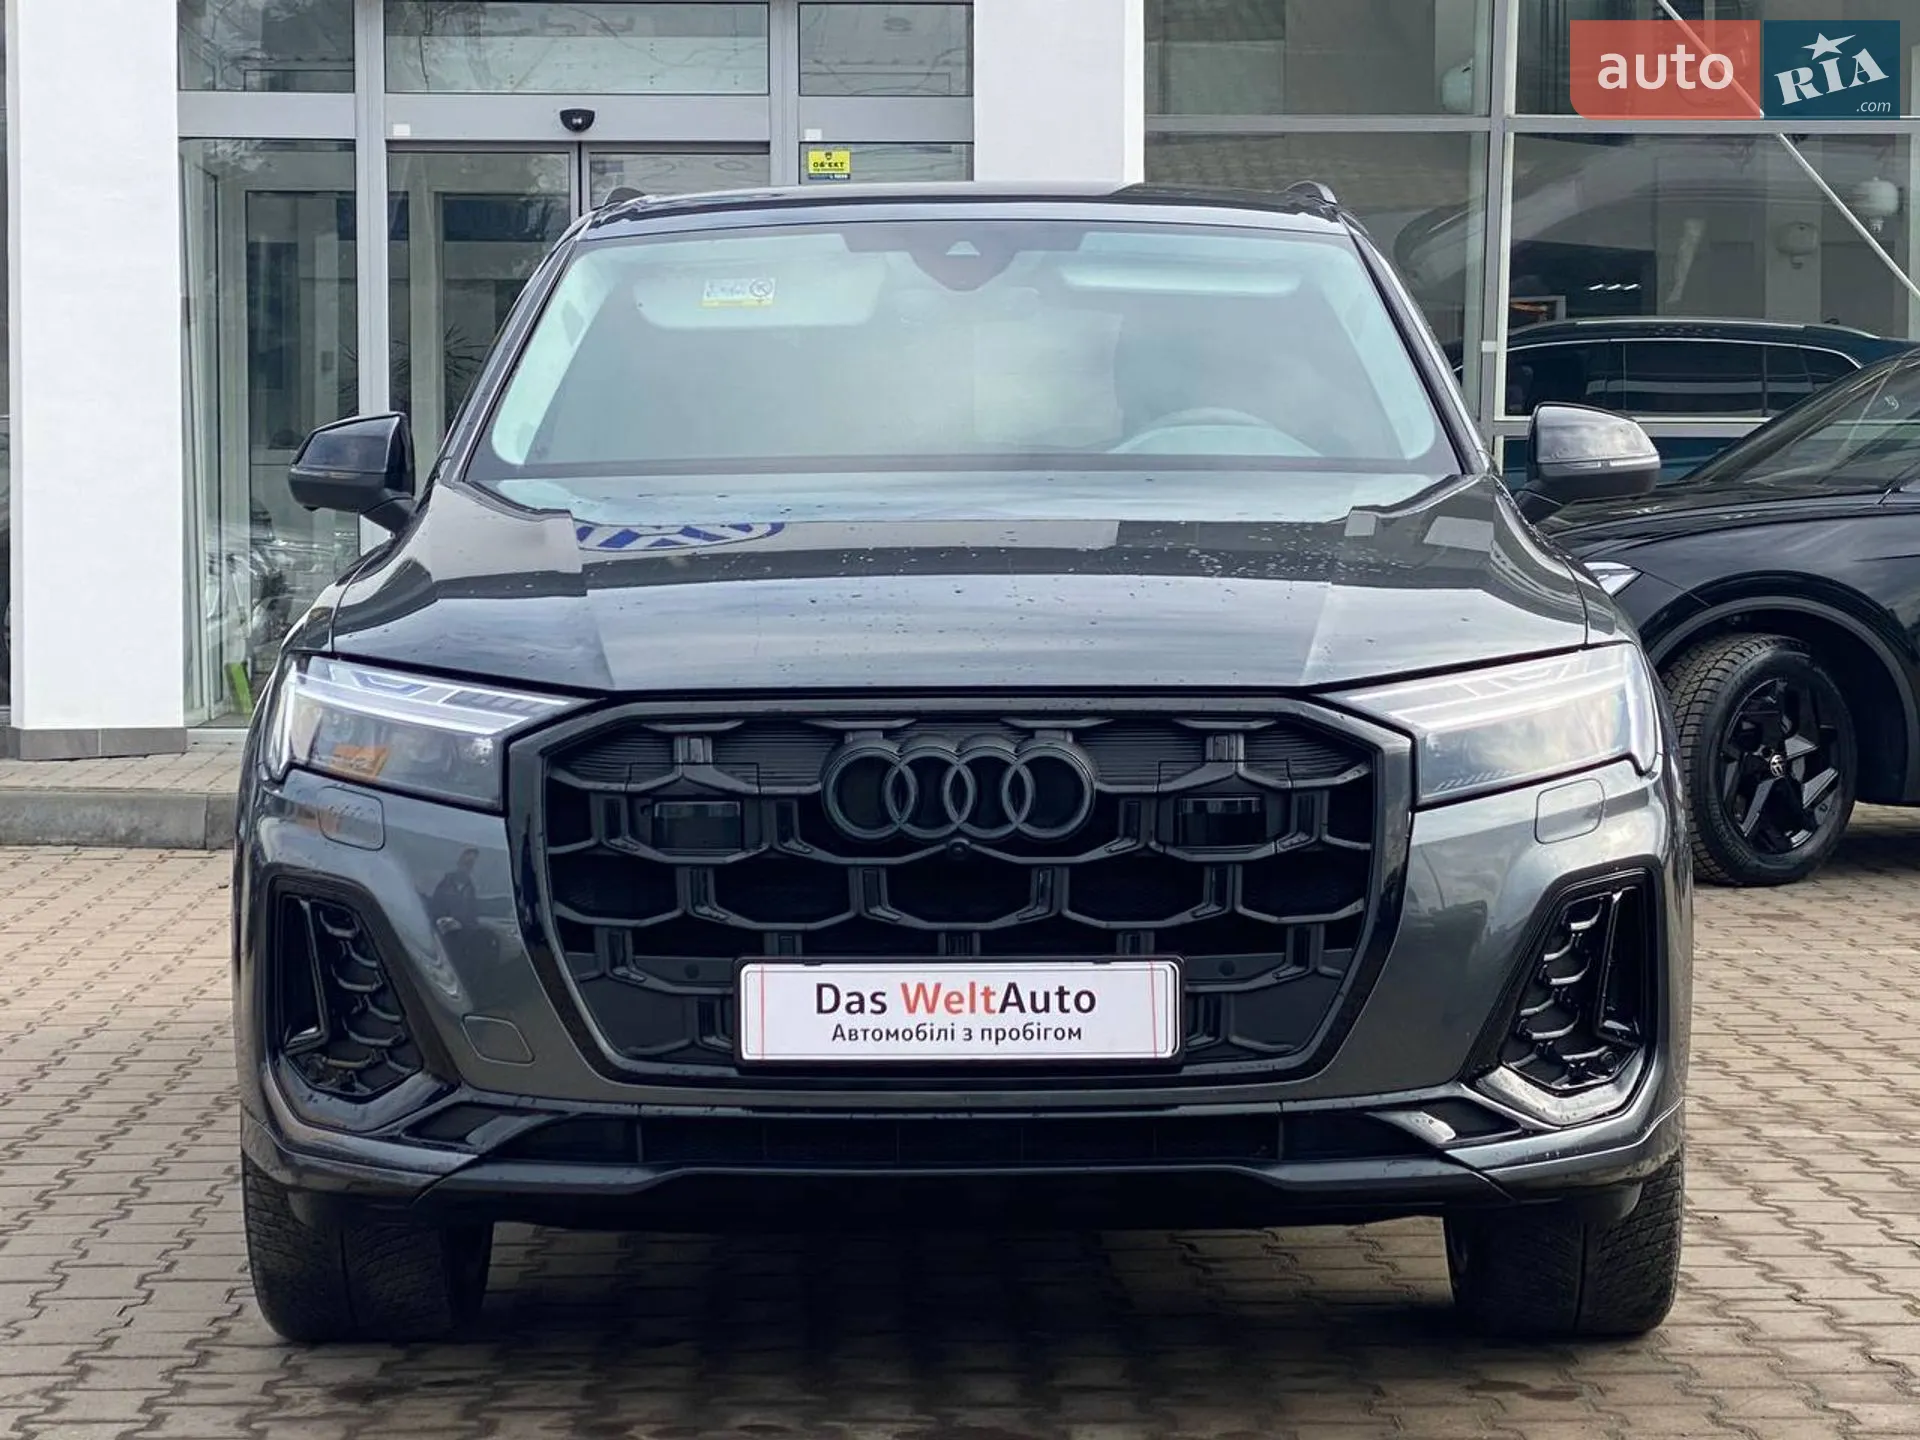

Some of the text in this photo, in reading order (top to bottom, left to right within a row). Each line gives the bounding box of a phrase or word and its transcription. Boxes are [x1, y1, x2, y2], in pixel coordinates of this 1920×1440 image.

[816, 982, 1096, 1014] Das WeltAuto
[832, 1023, 1082, 1045] Автомобілі з пробігом
